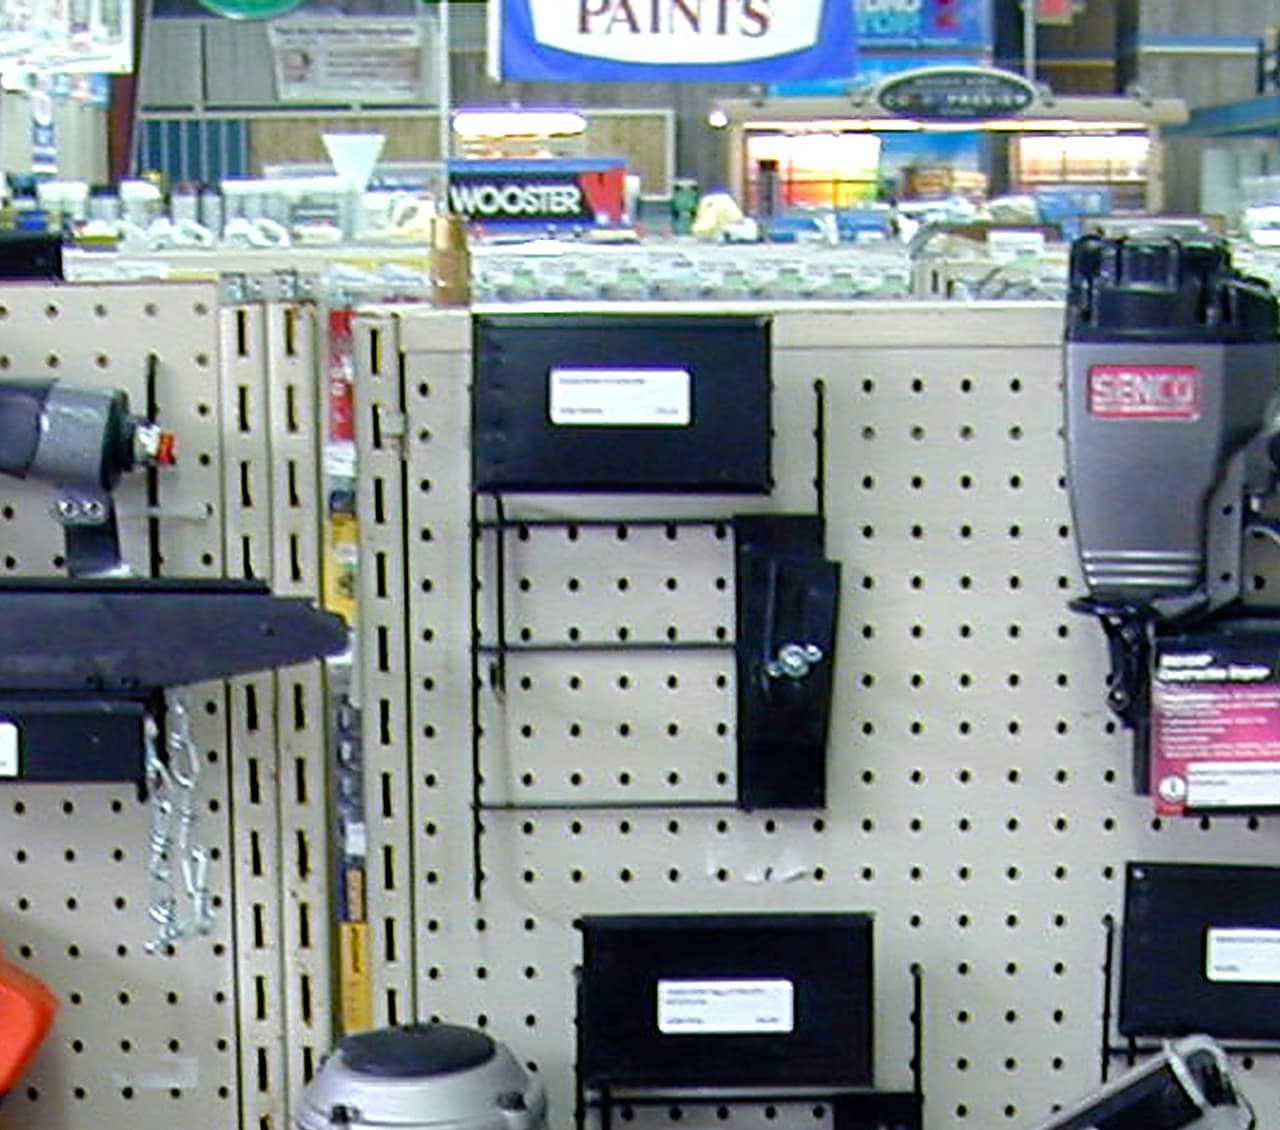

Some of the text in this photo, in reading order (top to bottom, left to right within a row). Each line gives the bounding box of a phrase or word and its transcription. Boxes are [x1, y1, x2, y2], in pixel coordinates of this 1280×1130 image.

[577, 0, 772, 37] PAINTS
[450, 184, 583, 219] WOOSTER
[1091, 371, 1195, 405] SENCO
